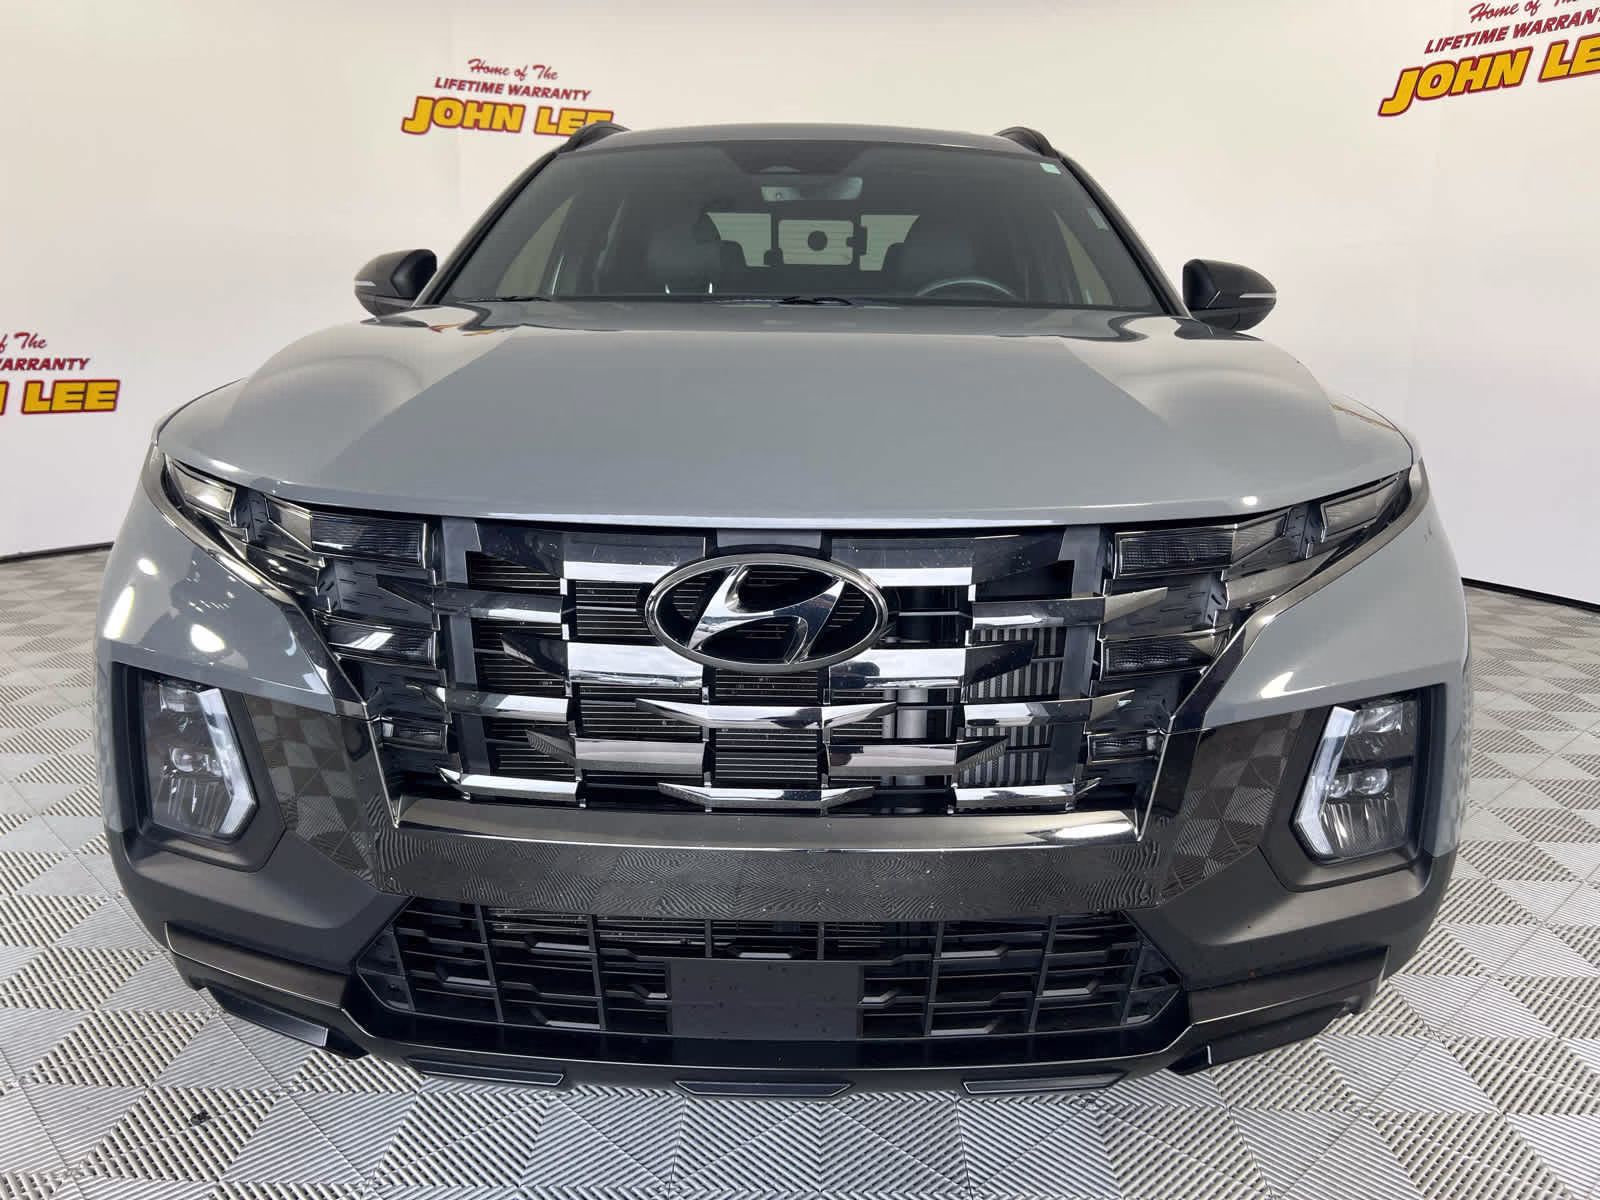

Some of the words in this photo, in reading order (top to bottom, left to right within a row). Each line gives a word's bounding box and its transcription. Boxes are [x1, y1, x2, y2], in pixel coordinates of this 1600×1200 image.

[1468, 0, 1519, 23] Home
[1523, 0, 1541, 16] of
[1424, 26, 1510, 54] LIFETIME
[1512, 8, 1600, 38] WARRAN
[467, 58, 510, 76] Home
[514, 64, 528, 81] of
[532, 64, 559, 81] The
[1377, 46, 1534, 117] JOHN
[434, 77, 505, 95] LIFETIME
[507, 84, 592, 101] WARRANTY
[401, 96, 526, 135] JOHN
[13, 332, 48, 349] The
[0, 357, 91, 371] ARRANTY
[21, 379, 121, 416] LEE
